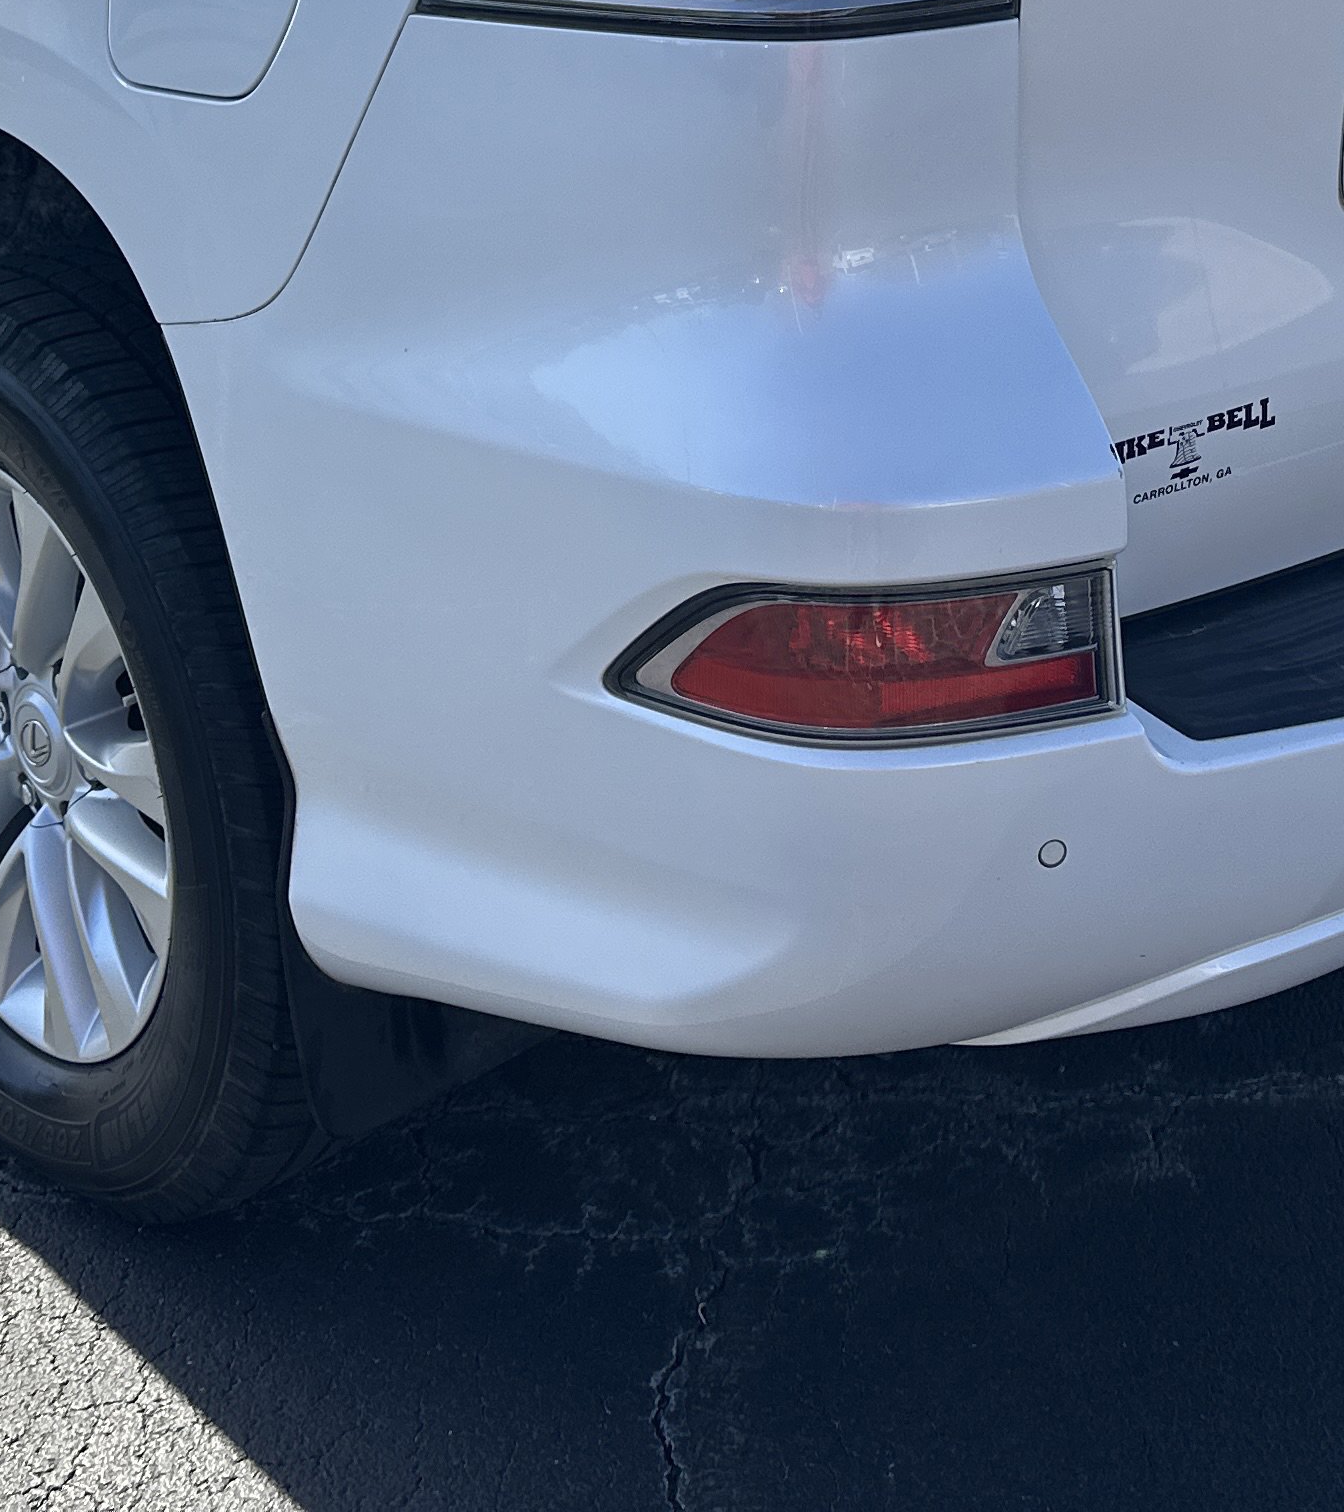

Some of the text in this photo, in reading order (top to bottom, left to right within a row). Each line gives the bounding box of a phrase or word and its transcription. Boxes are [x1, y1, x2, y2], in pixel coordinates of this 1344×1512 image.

[1206, 396, 1276, 433] BELL
[1132, 466, 1232, 504] CARROLLTON, GA
